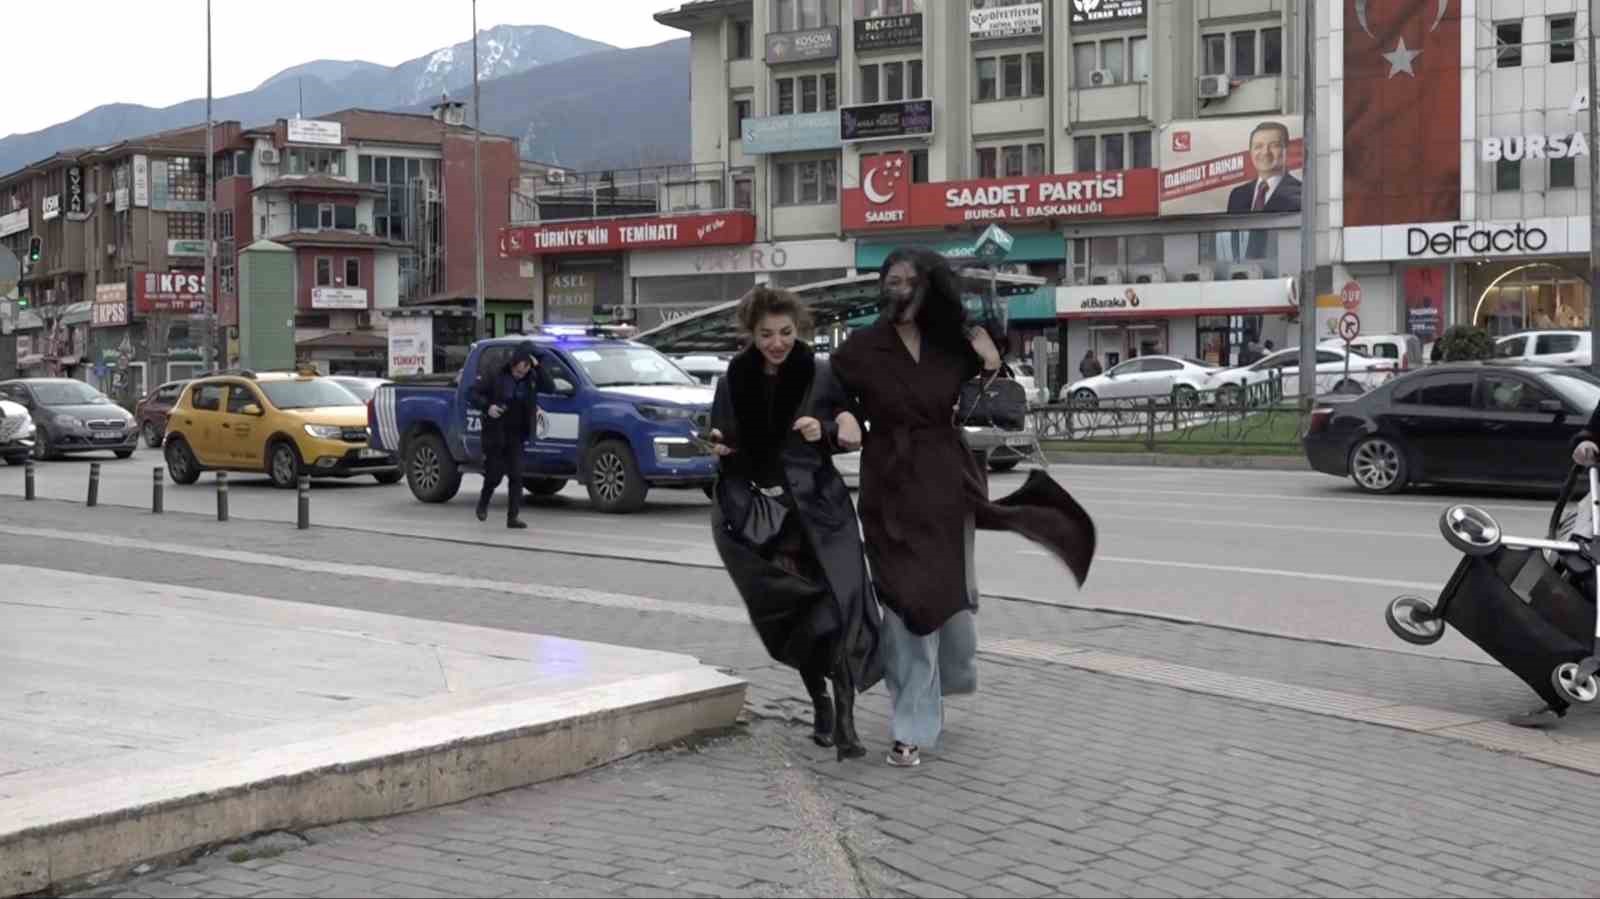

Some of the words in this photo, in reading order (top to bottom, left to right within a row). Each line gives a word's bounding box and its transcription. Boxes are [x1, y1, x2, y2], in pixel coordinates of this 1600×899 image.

[1482, 131, 1590, 161] BURSA
[945, 184, 1031, 208] SAADET
[1039, 174, 1124, 201] PARTİSİ
[865, 209, 905, 222] SAADET
[964, 207, 1006, 221] BURSA
[1010, 205, 1022, 218] İL
[1026, 202, 1103, 217] BAŞKANLIĞI
[534, 224, 608, 248] TÜRKİYE'NİN
[618, 222, 678, 243] TEMİNATI
[1407, 222, 1548, 256] DeFacto
[100, 303, 125, 322] KPSS
